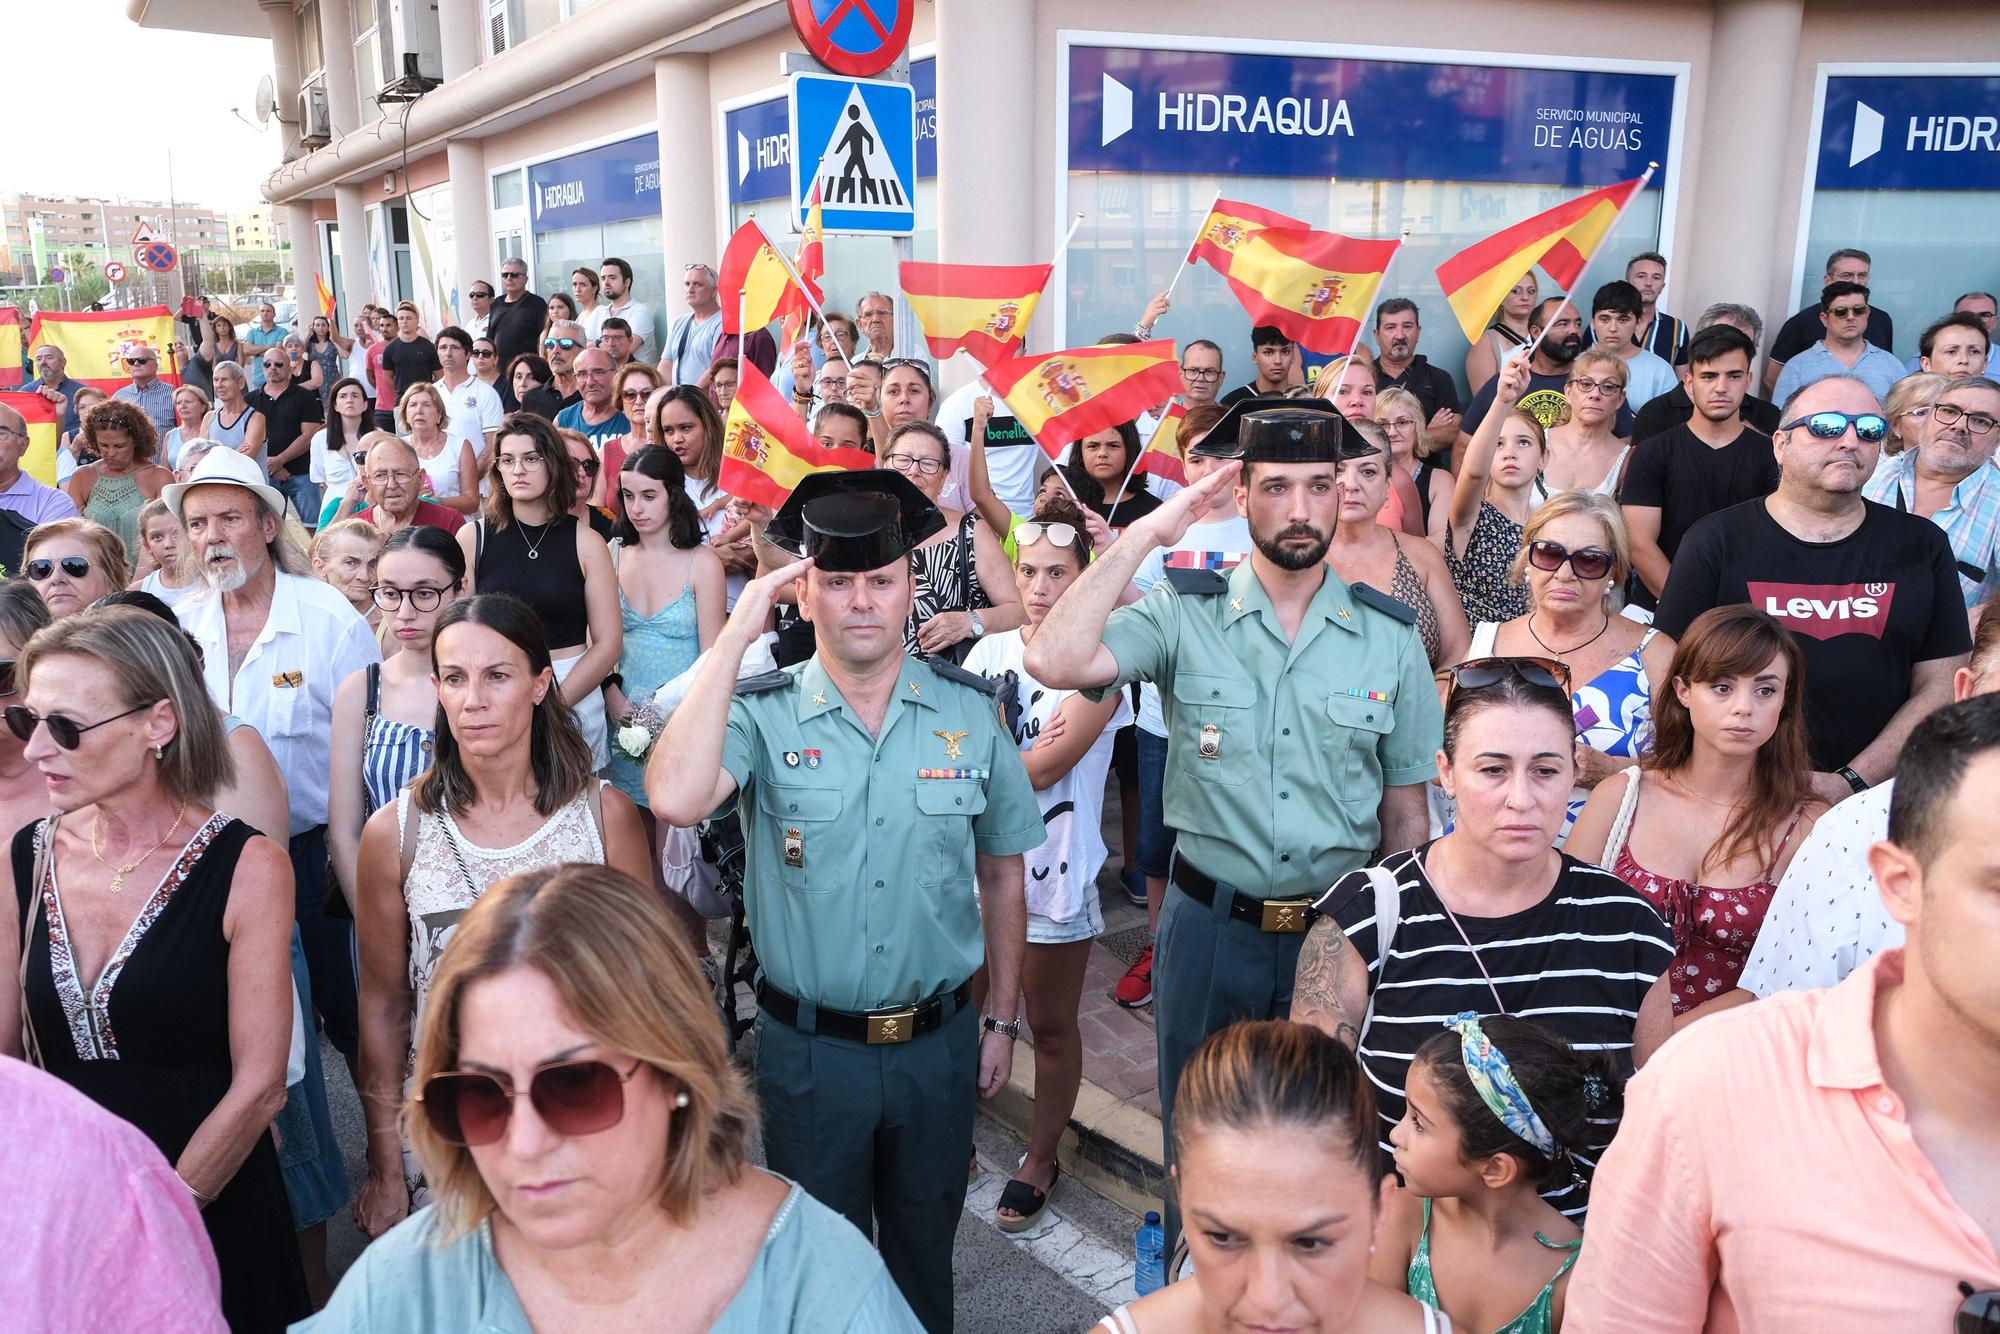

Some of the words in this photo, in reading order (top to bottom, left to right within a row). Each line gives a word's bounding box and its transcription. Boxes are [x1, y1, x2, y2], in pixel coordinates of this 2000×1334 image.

[1536, 107, 1584, 122] SERVICIO
[1586, 111, 1644, 125] MUNICIPAL
[1534, 124, 1564, 148] DE
[1568, 126, 1642, 151] AGUAS
[1906, 116, 2000, 152] HiDR
[634, 175, 645, 195] DE
